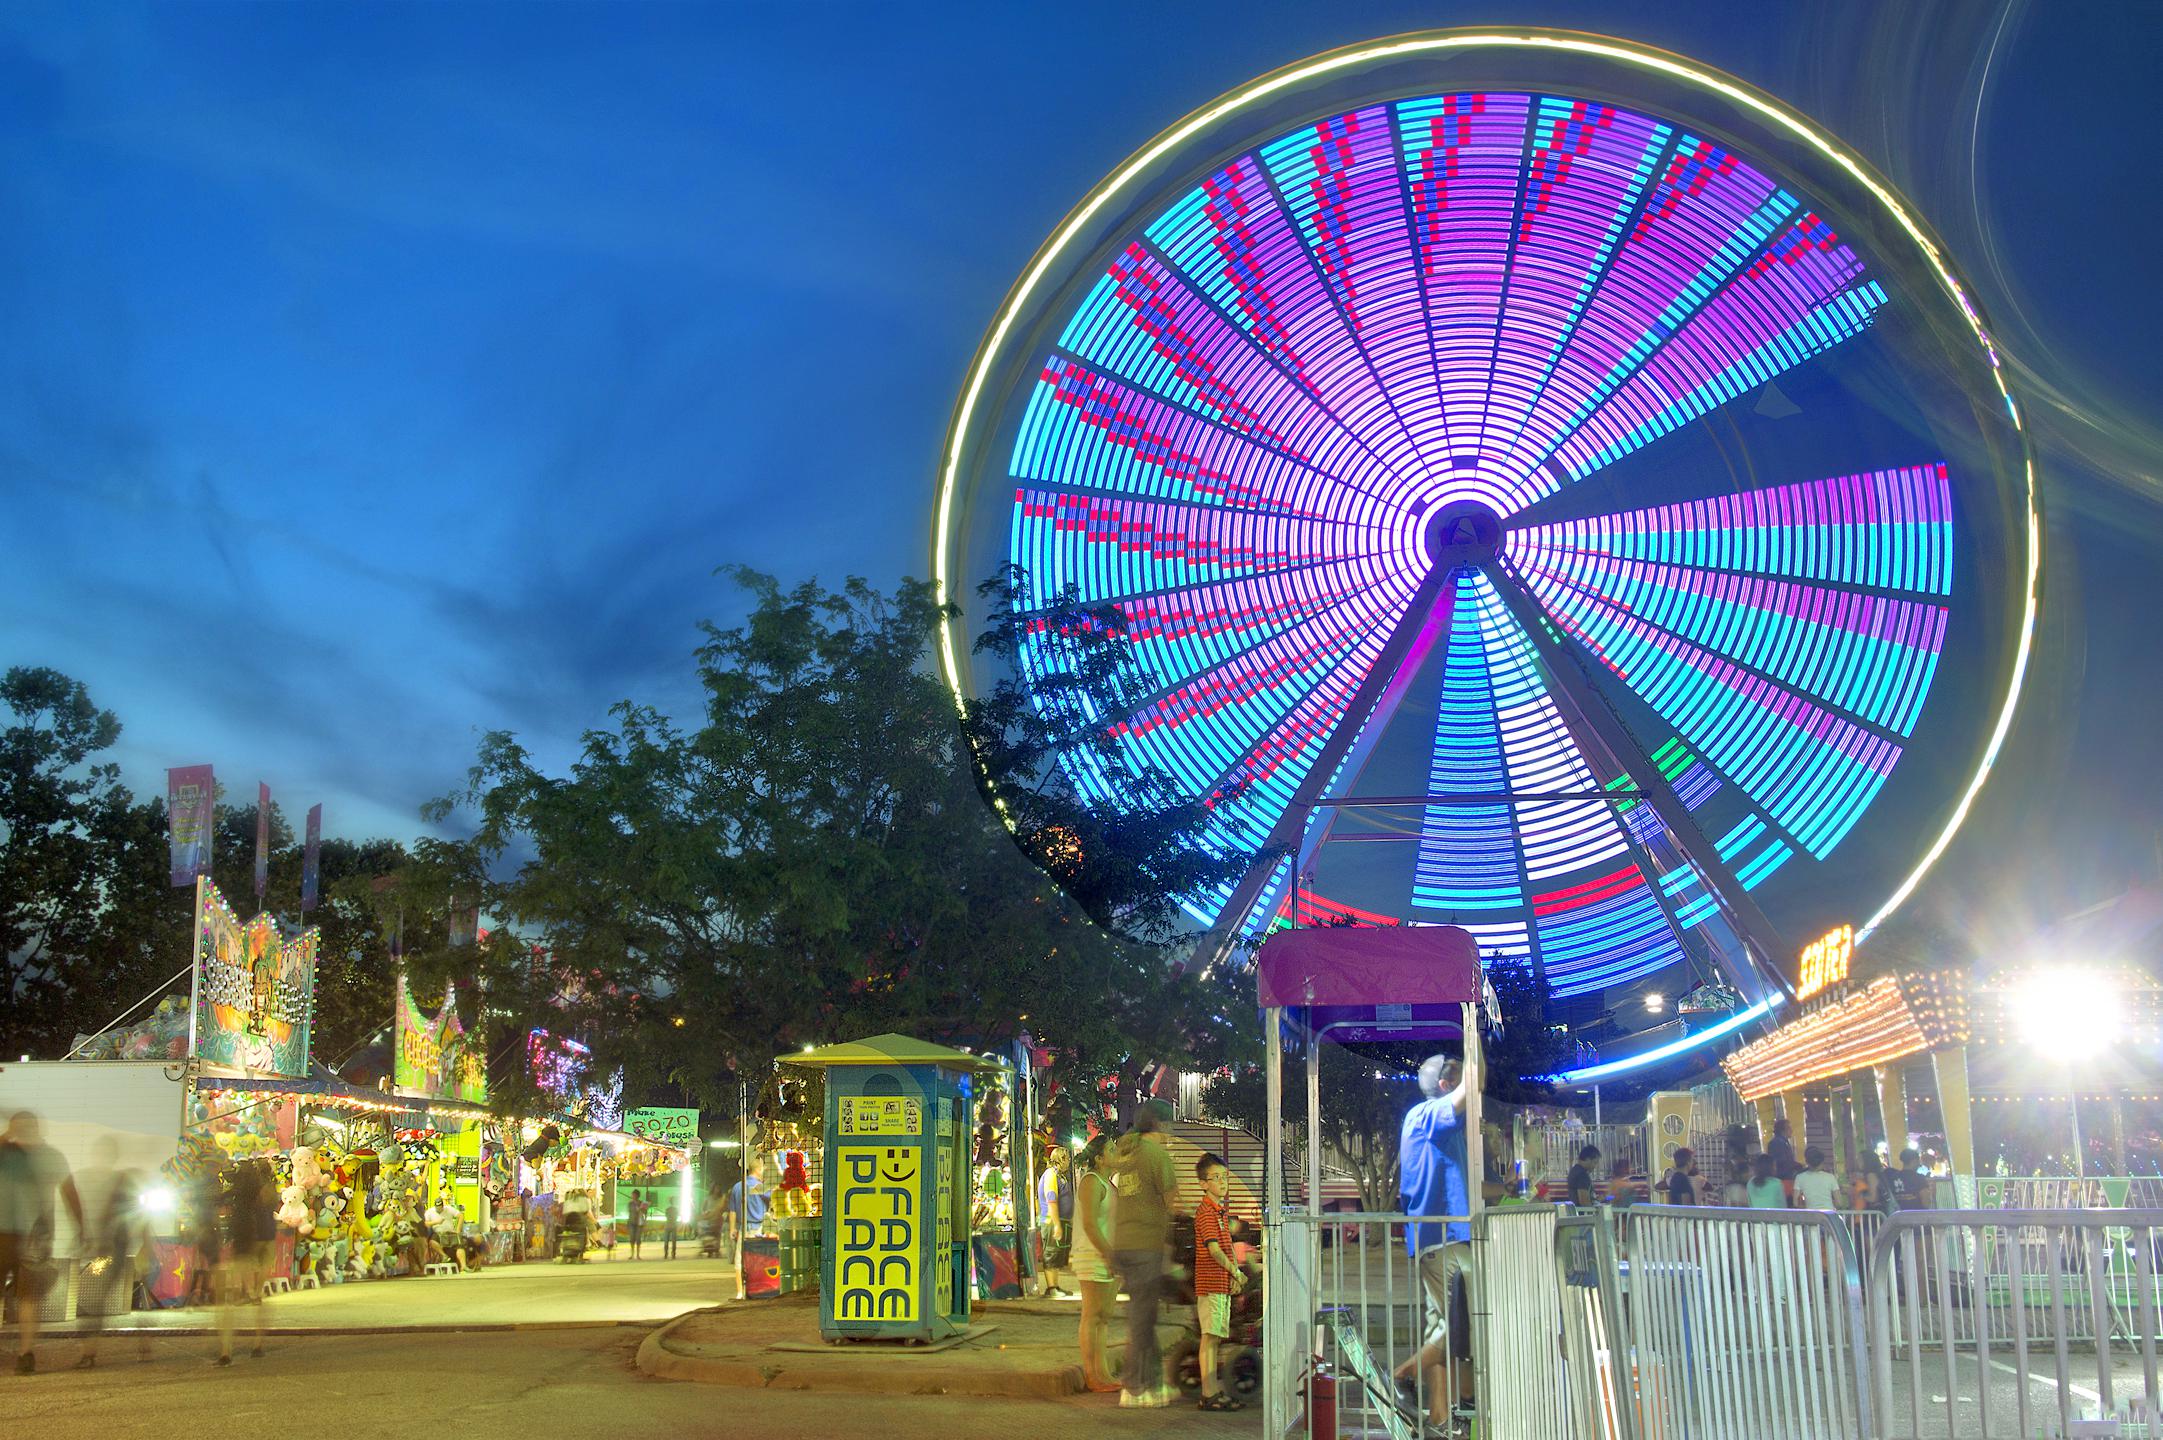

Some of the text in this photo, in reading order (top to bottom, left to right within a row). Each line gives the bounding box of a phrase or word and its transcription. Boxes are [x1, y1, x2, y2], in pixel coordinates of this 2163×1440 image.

[632, 1115, 690, 1132] BOZO
[841, 1154, 876, 1318] PLACE
[878, 1187, 912, 1318] FACE
